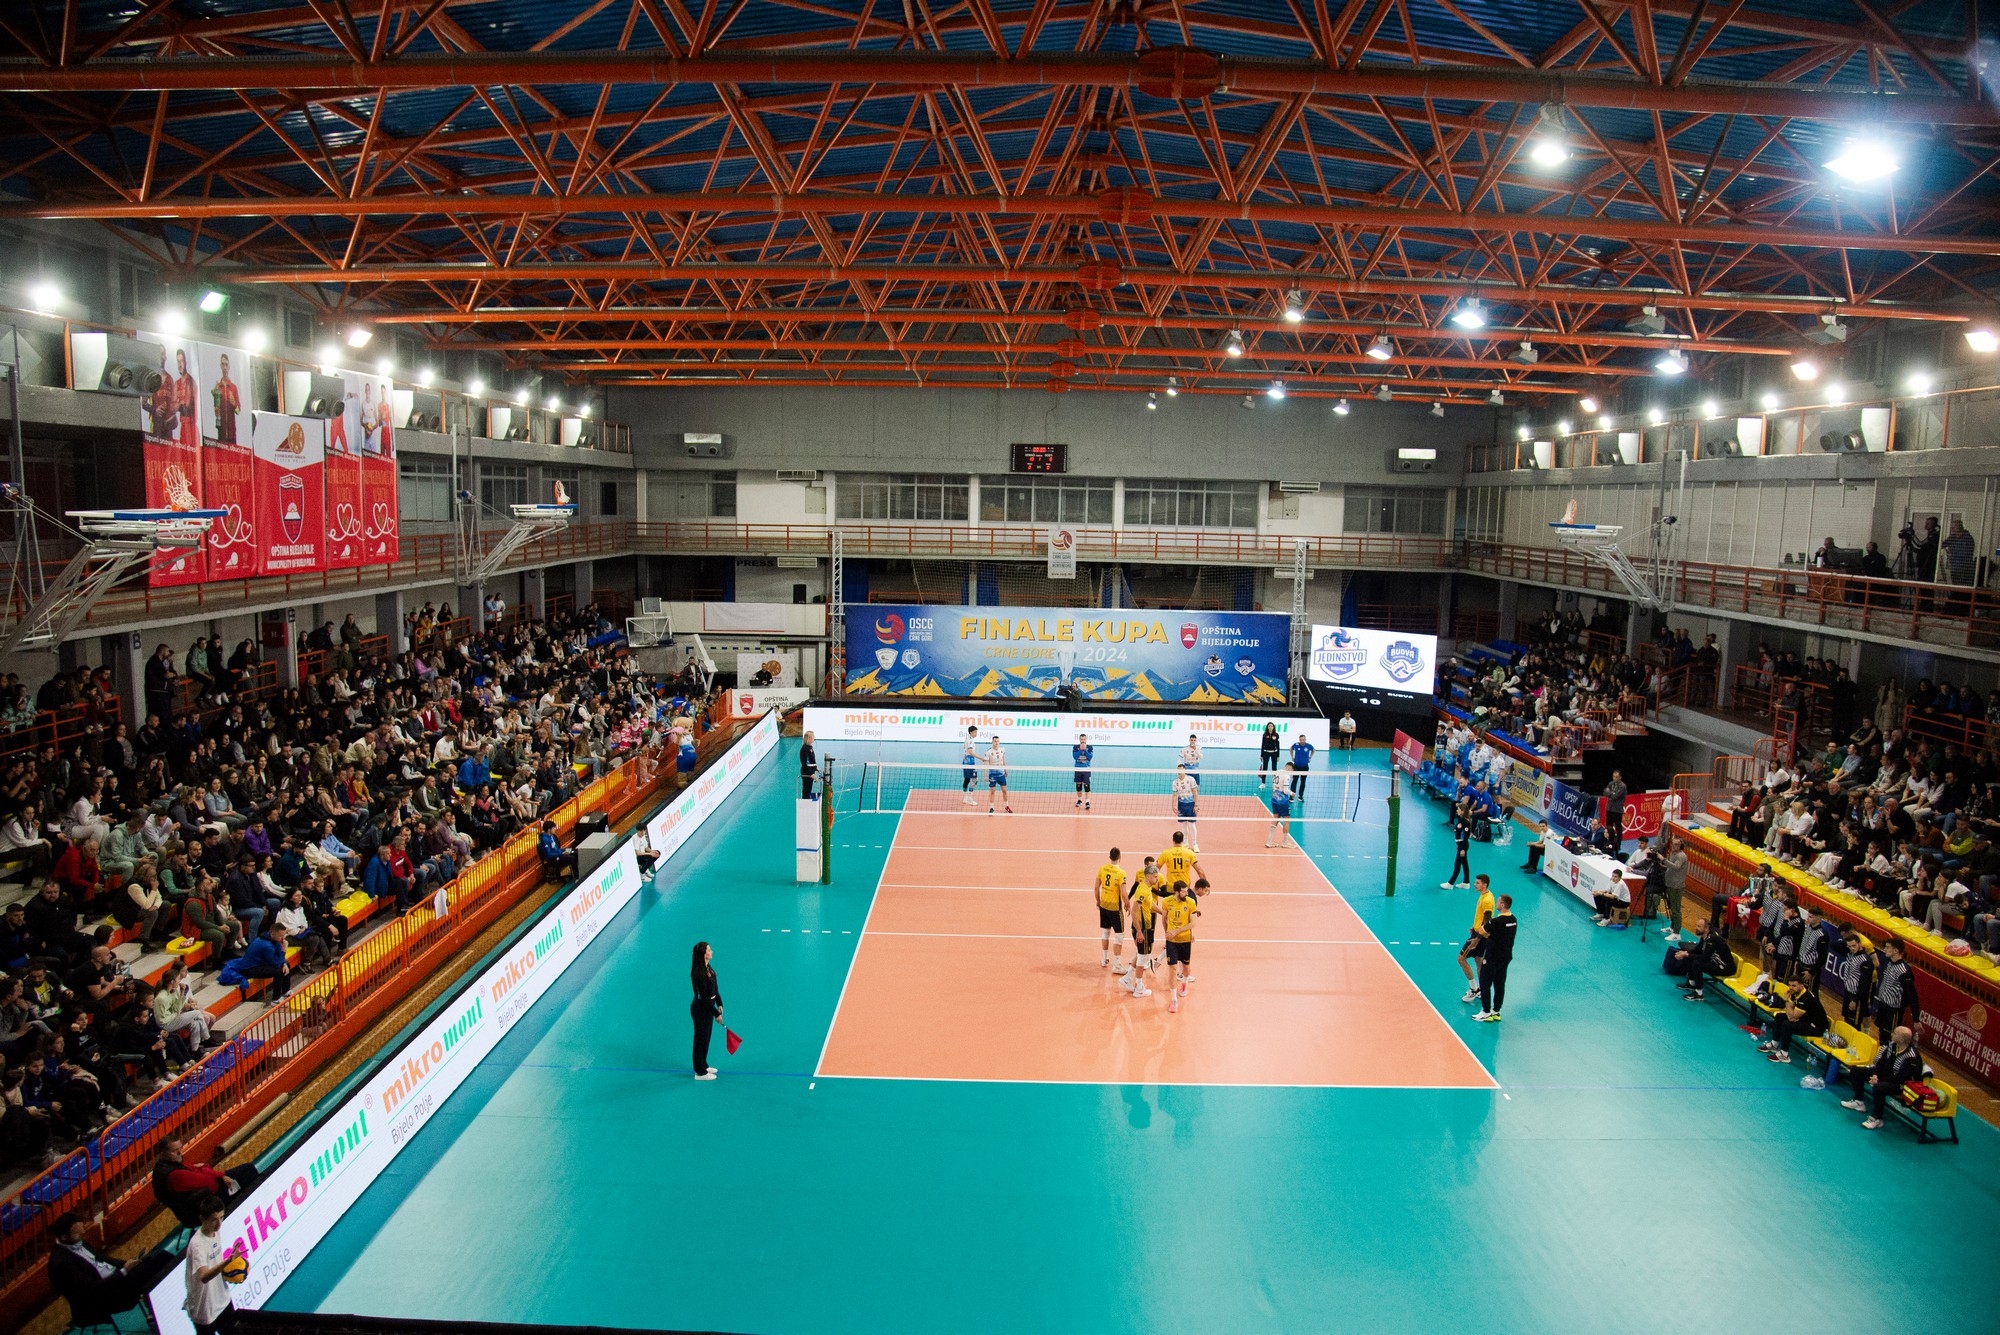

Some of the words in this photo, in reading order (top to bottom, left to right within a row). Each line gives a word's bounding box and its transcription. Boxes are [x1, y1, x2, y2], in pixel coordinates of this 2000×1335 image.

[909, 617, 933, 630] OSCG
[960, 618, 1075, 641] FINALE
[1082, 621, 1169, 644] KUPA
[1202, 625, 1241, 636] OPŠTINA
[1201, 638, 1232, 647] BIJELO
[1233, 639, 1260, 647] POLJE
[985, 646, 1017, 658] CRNE
[1020, 647, 1055, 659] GORE
[1083, 647, 1128, 662] 2024
[1317, 652, 1364, 662] JEDINSTVO
[1390, 648, 1415, 659] BUDVA
[1326, 685, 1367, 693] JEDINSTVO
[845, 712, 899, 724] mikro
[960, 715, 1014, 727] mikro
[1075, 717, 1129, 729] mikro
[1190, 720, 1244, 732] mikro
[844, 729, 863, 738] Bijelo
[865, 729, 881, 738] Polje
[1094, 734, 1111, 742] Polje
[1551, 797, 1572, 819] BIJELO
[660, 809, 681, 837] mikro
[1173, 857, 1183, 870] 14
[1105, 874, 1111, 887] 8
[570, 885, 601, 925] mikro
[492, 950, 535, 1004] mikro
[499, 1007, 515, 1029] Bijelo
[515, 992, 528, 1011] Polje
[1919, 1009, 1944, 1034] CENTAR
[1944, 1024, 1954, 1039] ZA
[1954, 1030, 1977, 1052] SPORT
[1977, 1043, 1981, 1055] I
[1932, 1033, 1962, 1059] BIJELO
[1964, 1052, 1991, 1077] POLJE
[383, 1041, 443, 1114] mikro
[392, 1115, 414, 1145] Bijelo
[414, 1094, 433, 1120] Polje
[263, 1247, 292, 1284] Polje
